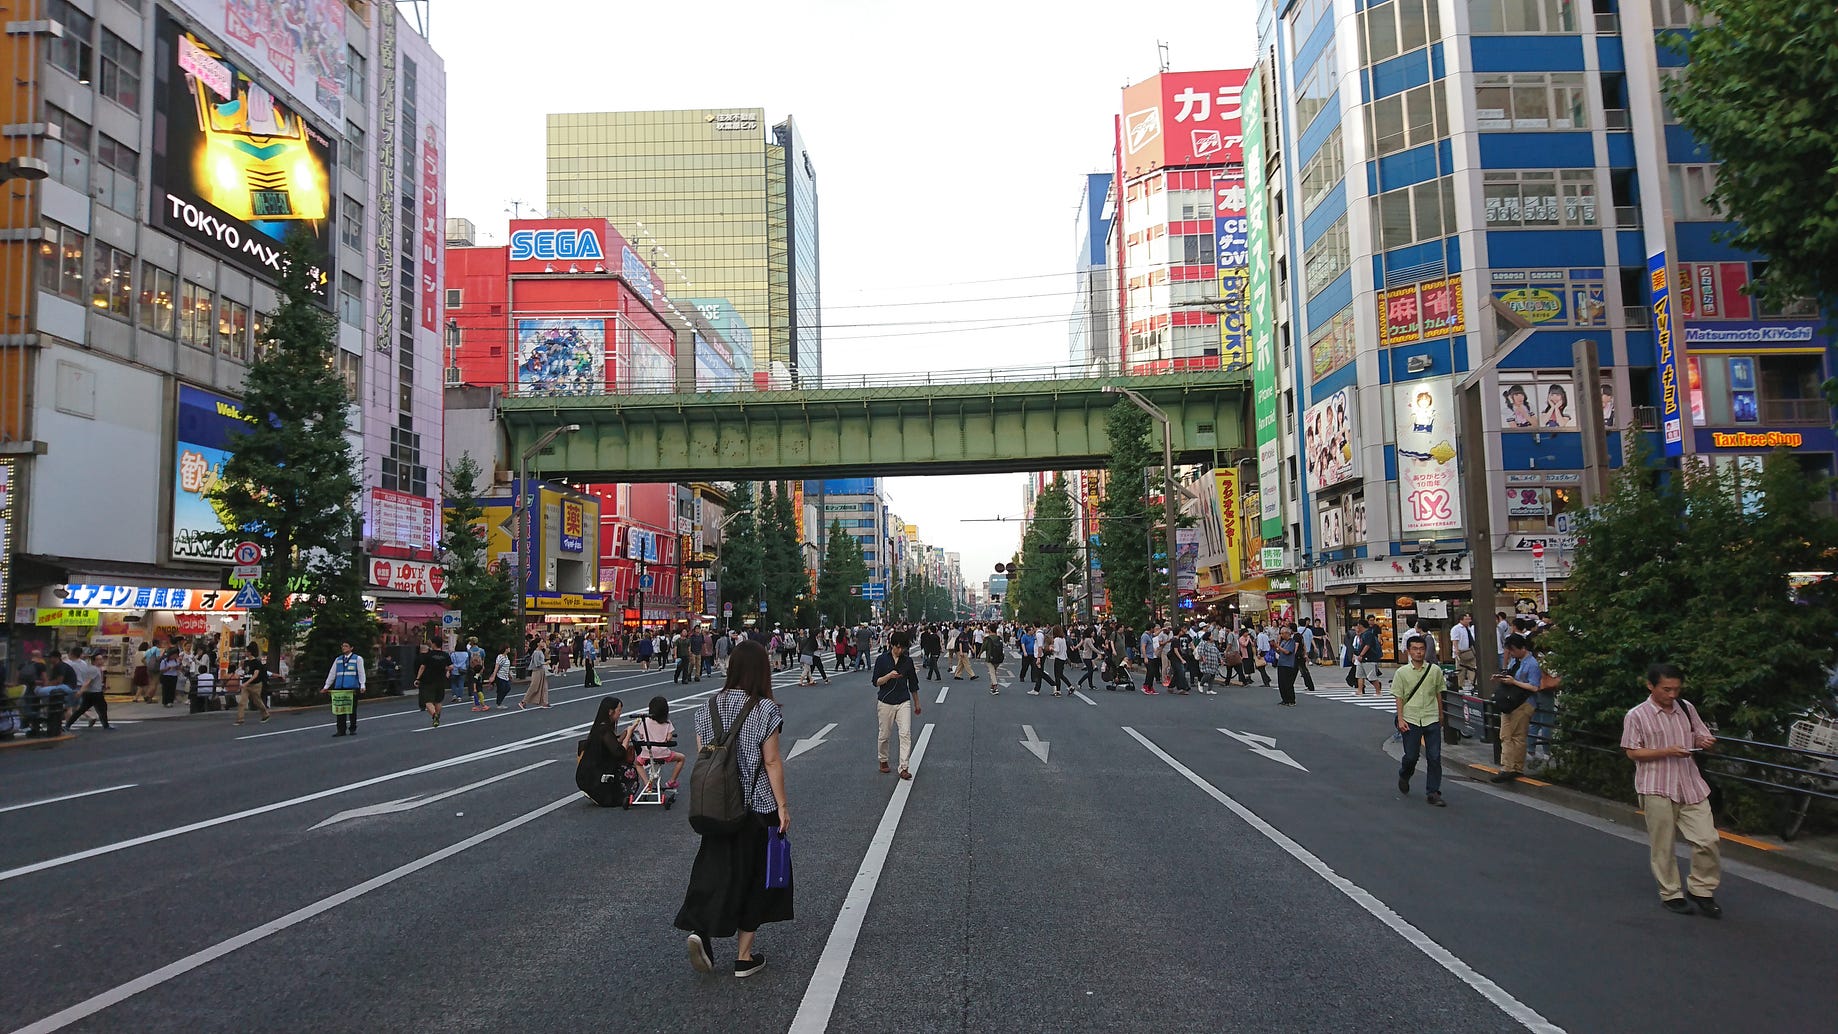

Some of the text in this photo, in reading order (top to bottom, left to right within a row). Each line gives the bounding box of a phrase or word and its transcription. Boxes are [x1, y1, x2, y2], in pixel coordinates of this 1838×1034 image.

[1218, 184, 1246, 212] 本
[166, 193, 240, 249] TOKYO
[242, 238, 280, 271] MX
[510, 228, 605, 261] SEGA
[622, 245, 653, 306] SEGA
[1652, 268, 1665, 291] 薬
[1388, 289, 1456, 322] 麻雀
[1389, 317, 1445, 336] ウェルカム
[1685, 327, 1812, 342] Matsumoto KiYoshi
[1654, 295, 1676, 414] マツモトキヨシ
[1712, 432, 1802, 447] Tax Free Shop
[1412, 473, 1447, 482] ありがとう
[1222, 479, 1235, 548] ラジオセンター
[627, 527, 658, 563] SEGA
[1263, 549, 1281, 559] 携帯
[396, 563, 425, 580] LOVE
[1264, 558, 1281, 568] 買取
[1408, 557, 1463, 574] 富士そば
